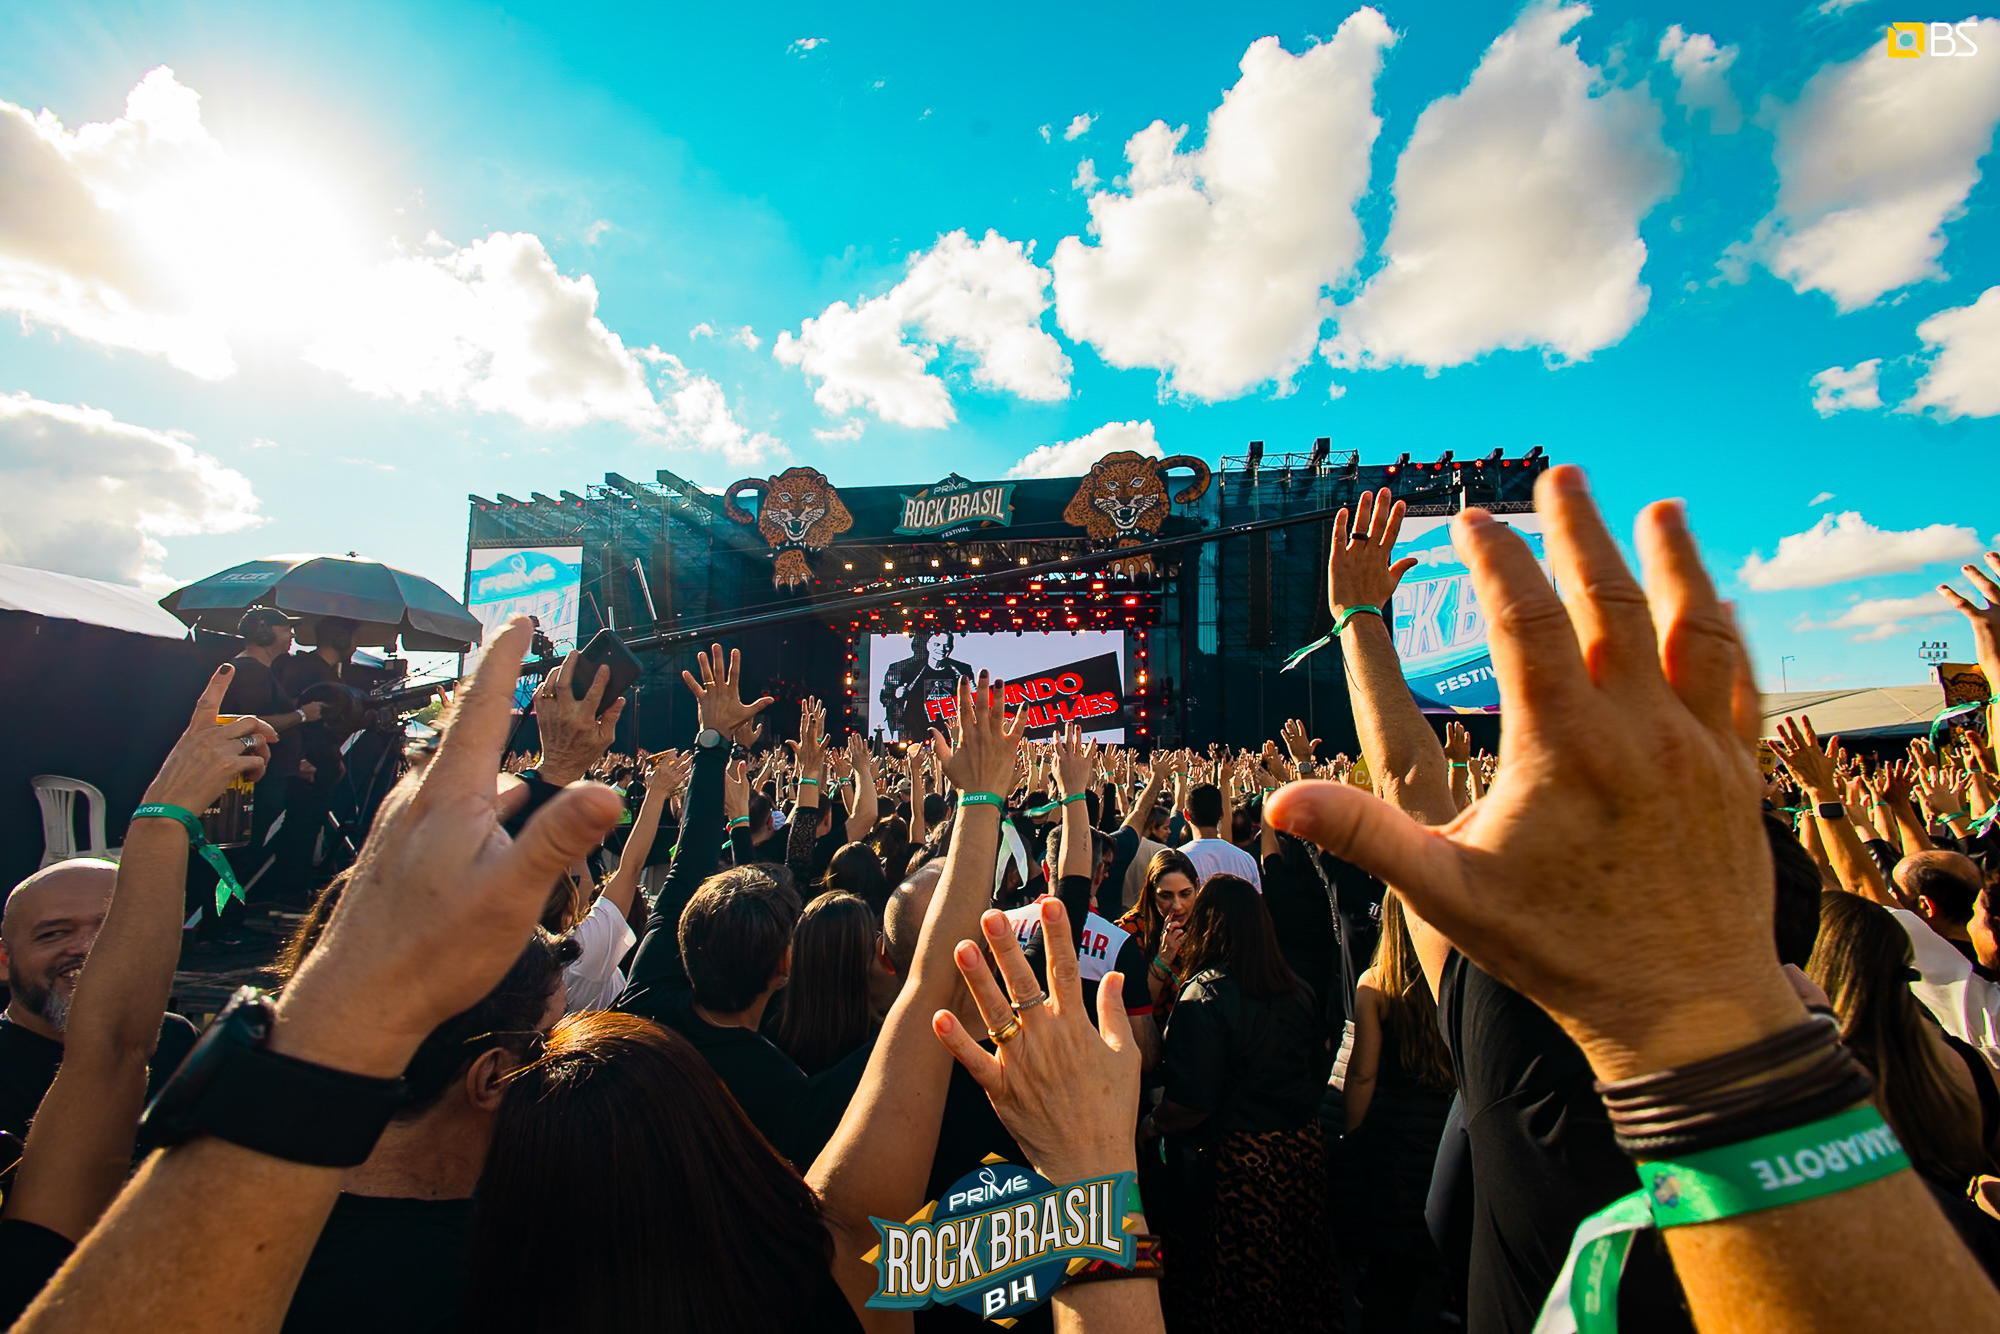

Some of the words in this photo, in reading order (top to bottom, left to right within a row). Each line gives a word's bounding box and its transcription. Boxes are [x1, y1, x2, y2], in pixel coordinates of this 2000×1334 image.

[933, 479, 969, 495] PRIME
[903, 498, 947, 528] ROCK
[948, 487, 1005, 522] BRASIL
[941, 526, 970, 539] FESTIVAL
[478, 557, 556, 596] PRIME
